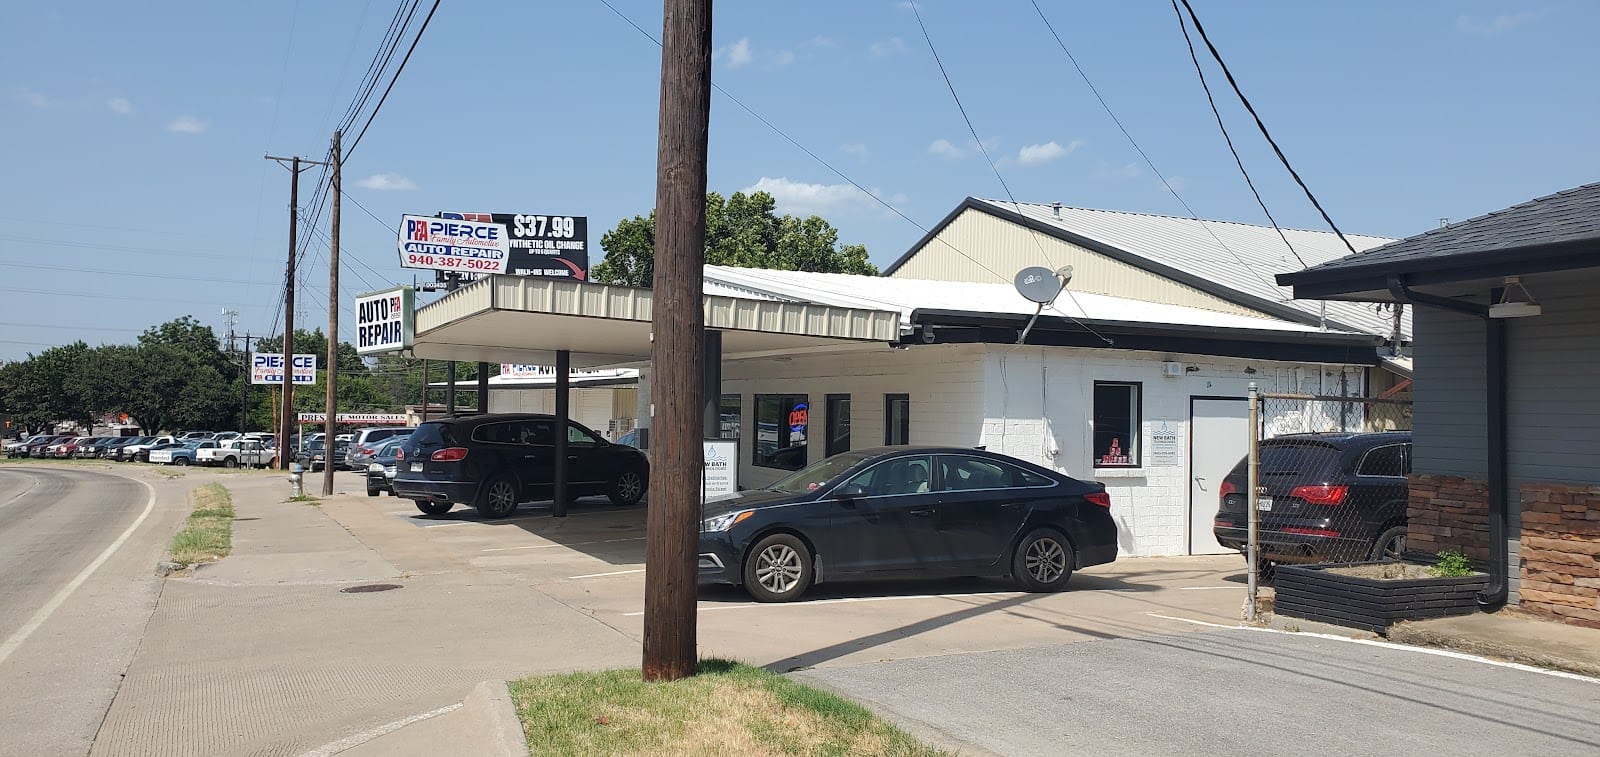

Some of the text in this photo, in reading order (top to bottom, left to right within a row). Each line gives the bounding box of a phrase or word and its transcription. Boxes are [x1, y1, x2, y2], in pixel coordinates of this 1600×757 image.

[407, 220, 428, 241] PFA
[430, 222, 498, 240] PIERCE
[514, 214, 574, 238] $37.99
[431, 233, 500, 248] Family Automotive
[510, 239, 584, 250] YNTHETIC OIL CHANGE
[407, 243, 503, 259] AUTO REPAIR
[408, 254, 500, 271] 940-387-5022
[515, 268, 570, 277] WALK-INS WELCOME
[359, 296, 401, 325] AUTO PFA
[359, 320, 402, 348] REPAIR
